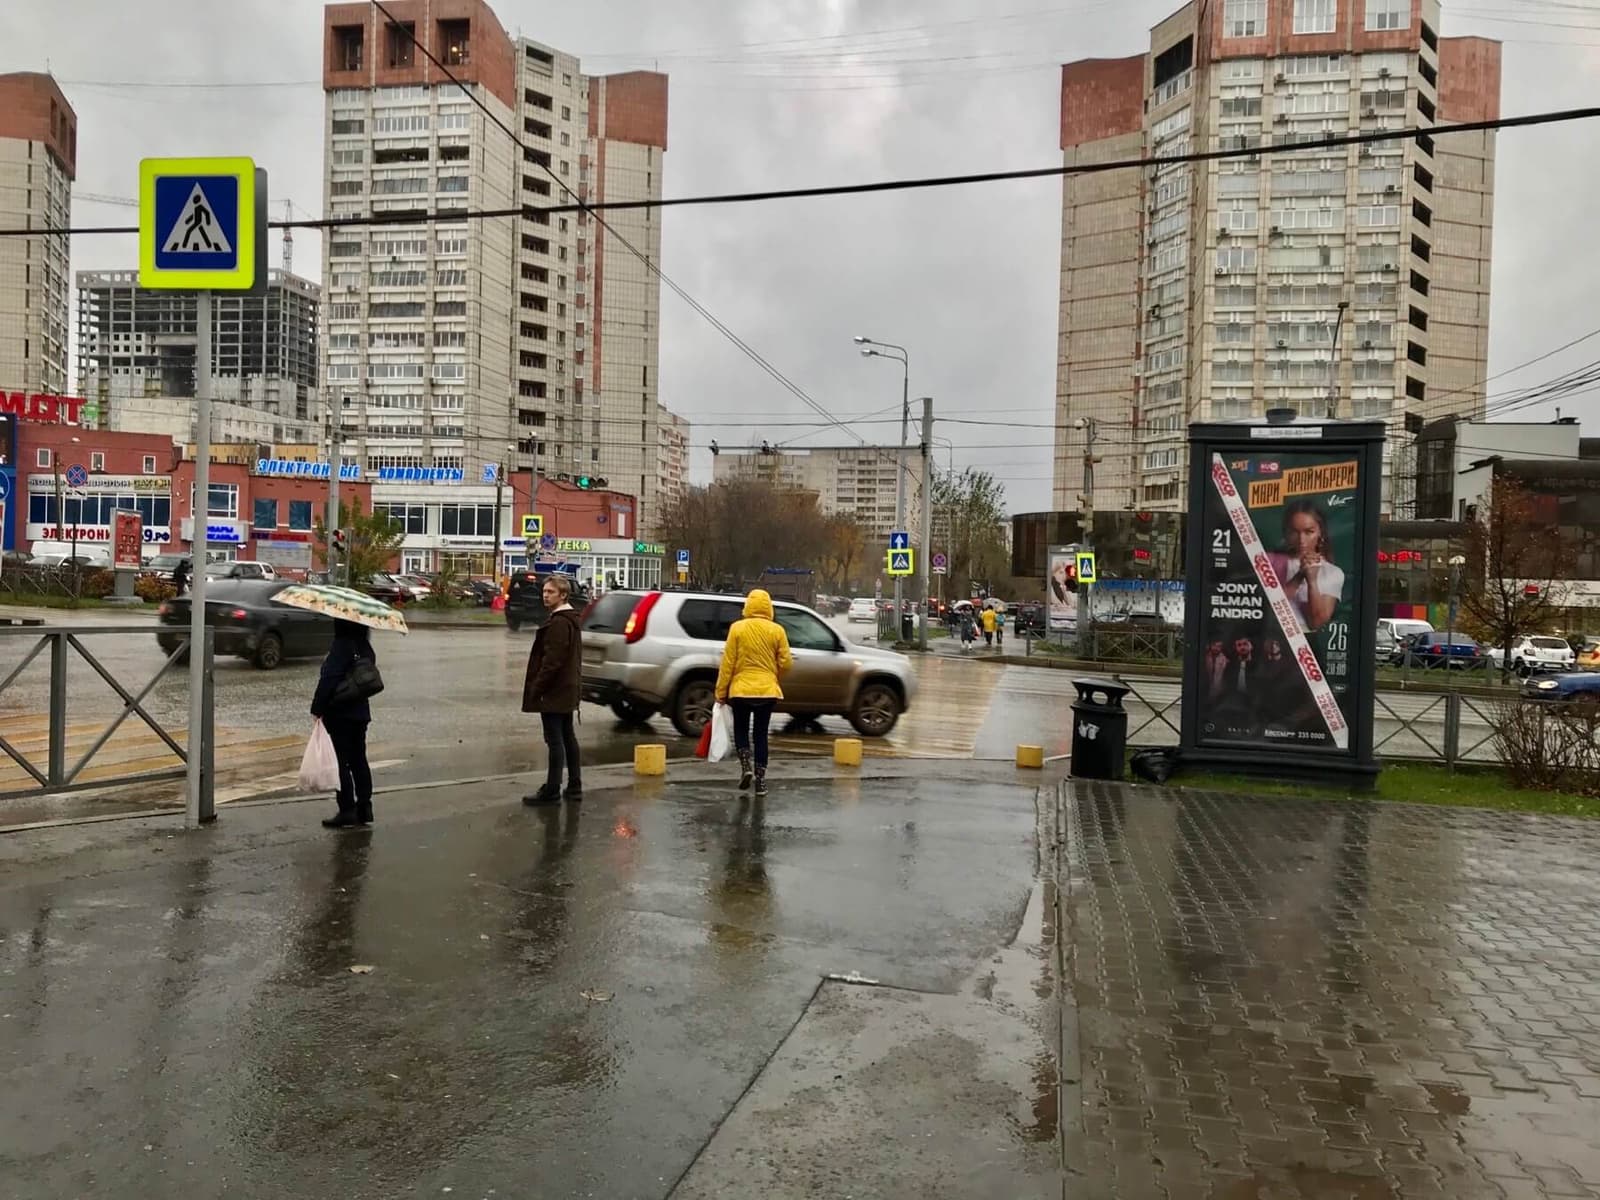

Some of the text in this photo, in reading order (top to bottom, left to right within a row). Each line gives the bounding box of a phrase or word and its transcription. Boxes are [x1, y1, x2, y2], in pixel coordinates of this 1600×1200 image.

[259, 459, 464, 481] ЭЛЕКТРОНЫЕ КОМПОНЕНТЫ
[1251, 465, 1355, 505] МАРИ КРАЙМБРЕРИ
[1212, 528, 1231, 548] 21
[1216, 582, 1258, 594] JONY
[1211, 595, 1263, 607] ELMAN
[1211, 607, 1264, 620] ANDRO
[1327, 622, 1348, 651] 26
